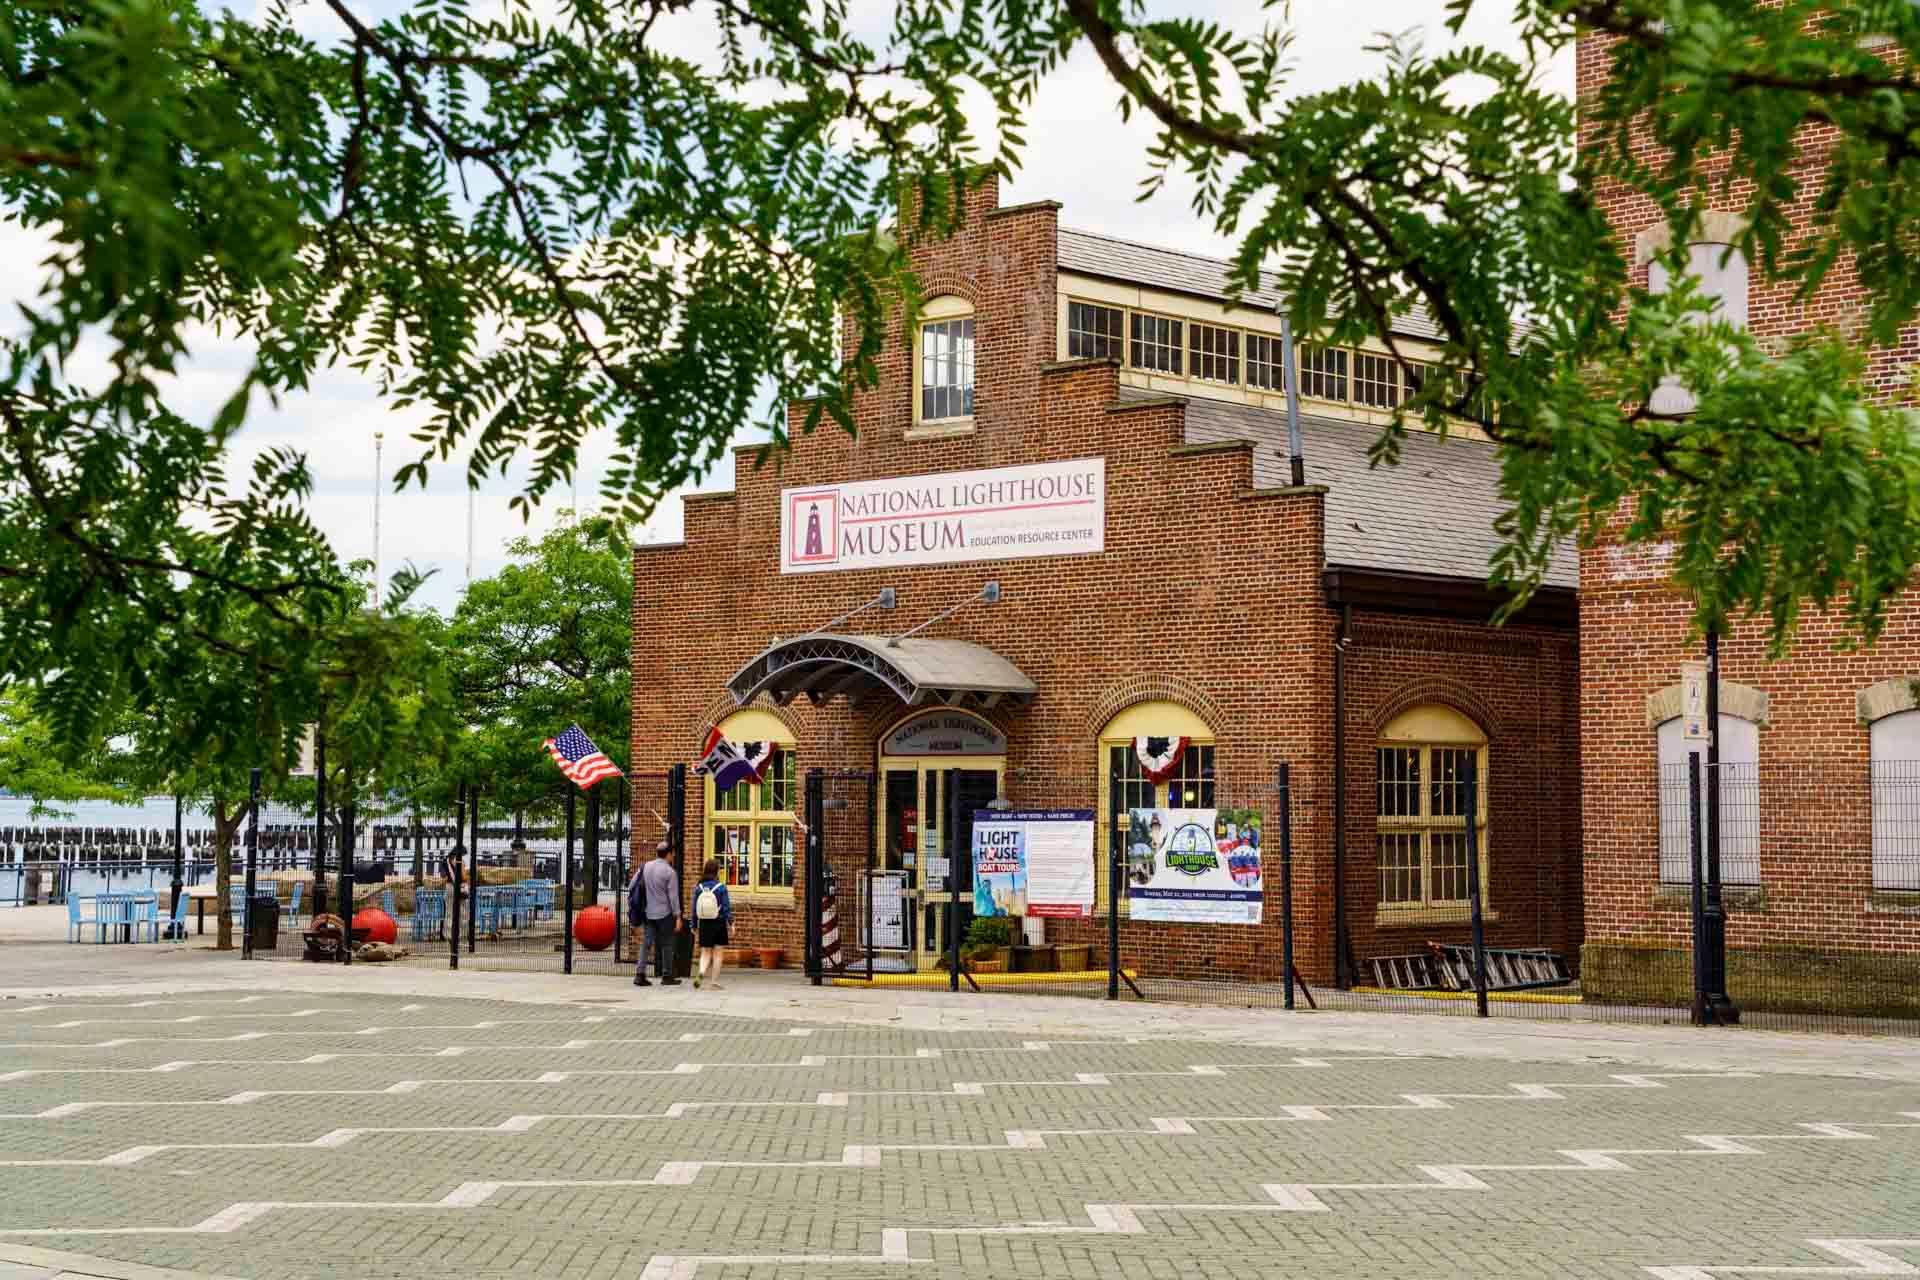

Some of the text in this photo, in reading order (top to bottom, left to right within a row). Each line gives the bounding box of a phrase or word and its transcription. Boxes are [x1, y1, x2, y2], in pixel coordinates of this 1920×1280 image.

[841, 472, 1096, 516] NATIONAL LIGHTHOUSE
[841, 519, 966, 556] MUSEUM
[970, 528, 1094, 547] EDUCATION RESOURCE CENTER
[980, 831, 1019, 845] LIGHT
[978, 863, 1020, 873] BOAT TOURS
[1167, 854, 1216, 867] LIGHTHOUSE
